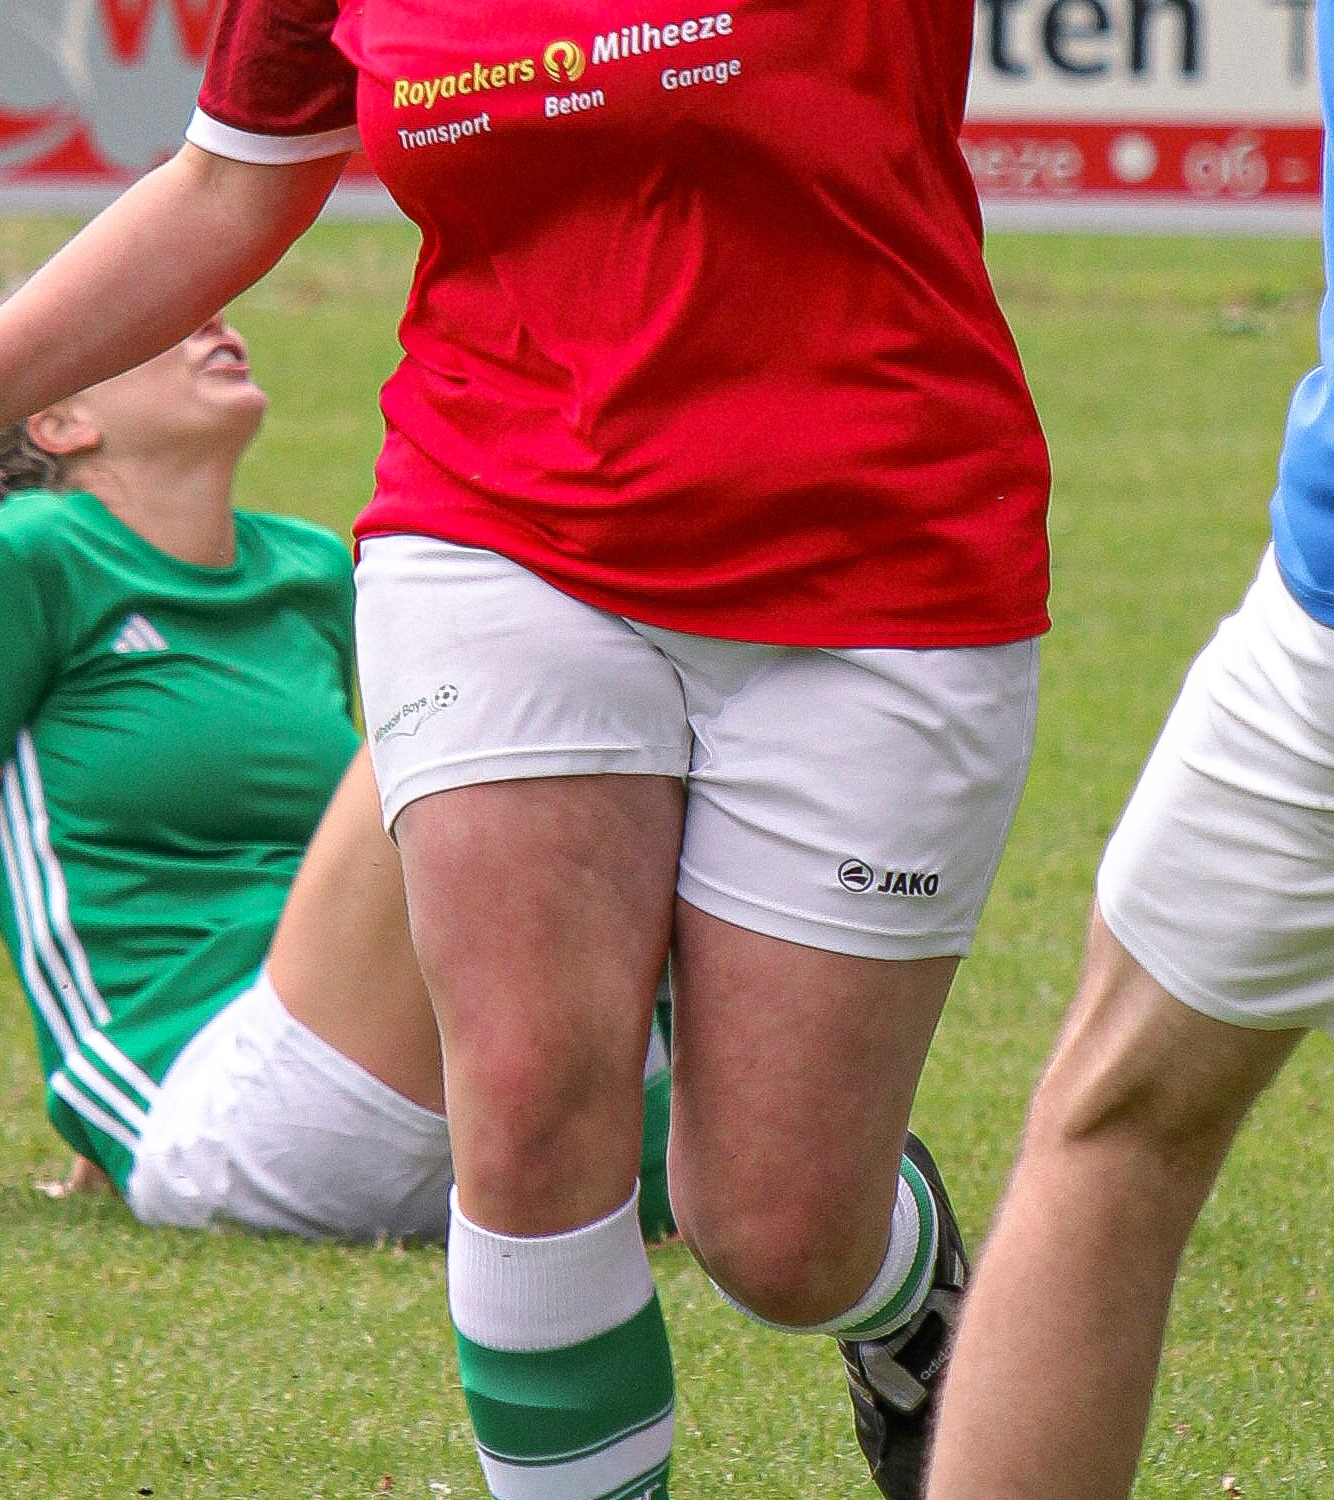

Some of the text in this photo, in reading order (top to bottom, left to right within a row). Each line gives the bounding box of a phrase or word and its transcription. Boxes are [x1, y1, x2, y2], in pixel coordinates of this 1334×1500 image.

[392, 12, 733, 109] Royackers Milheeze
[397, 57, 742, 150] Transport Beton Garage
[402, 696, 427, 717] Boys
[877, 871, 940, 896] JAKO
